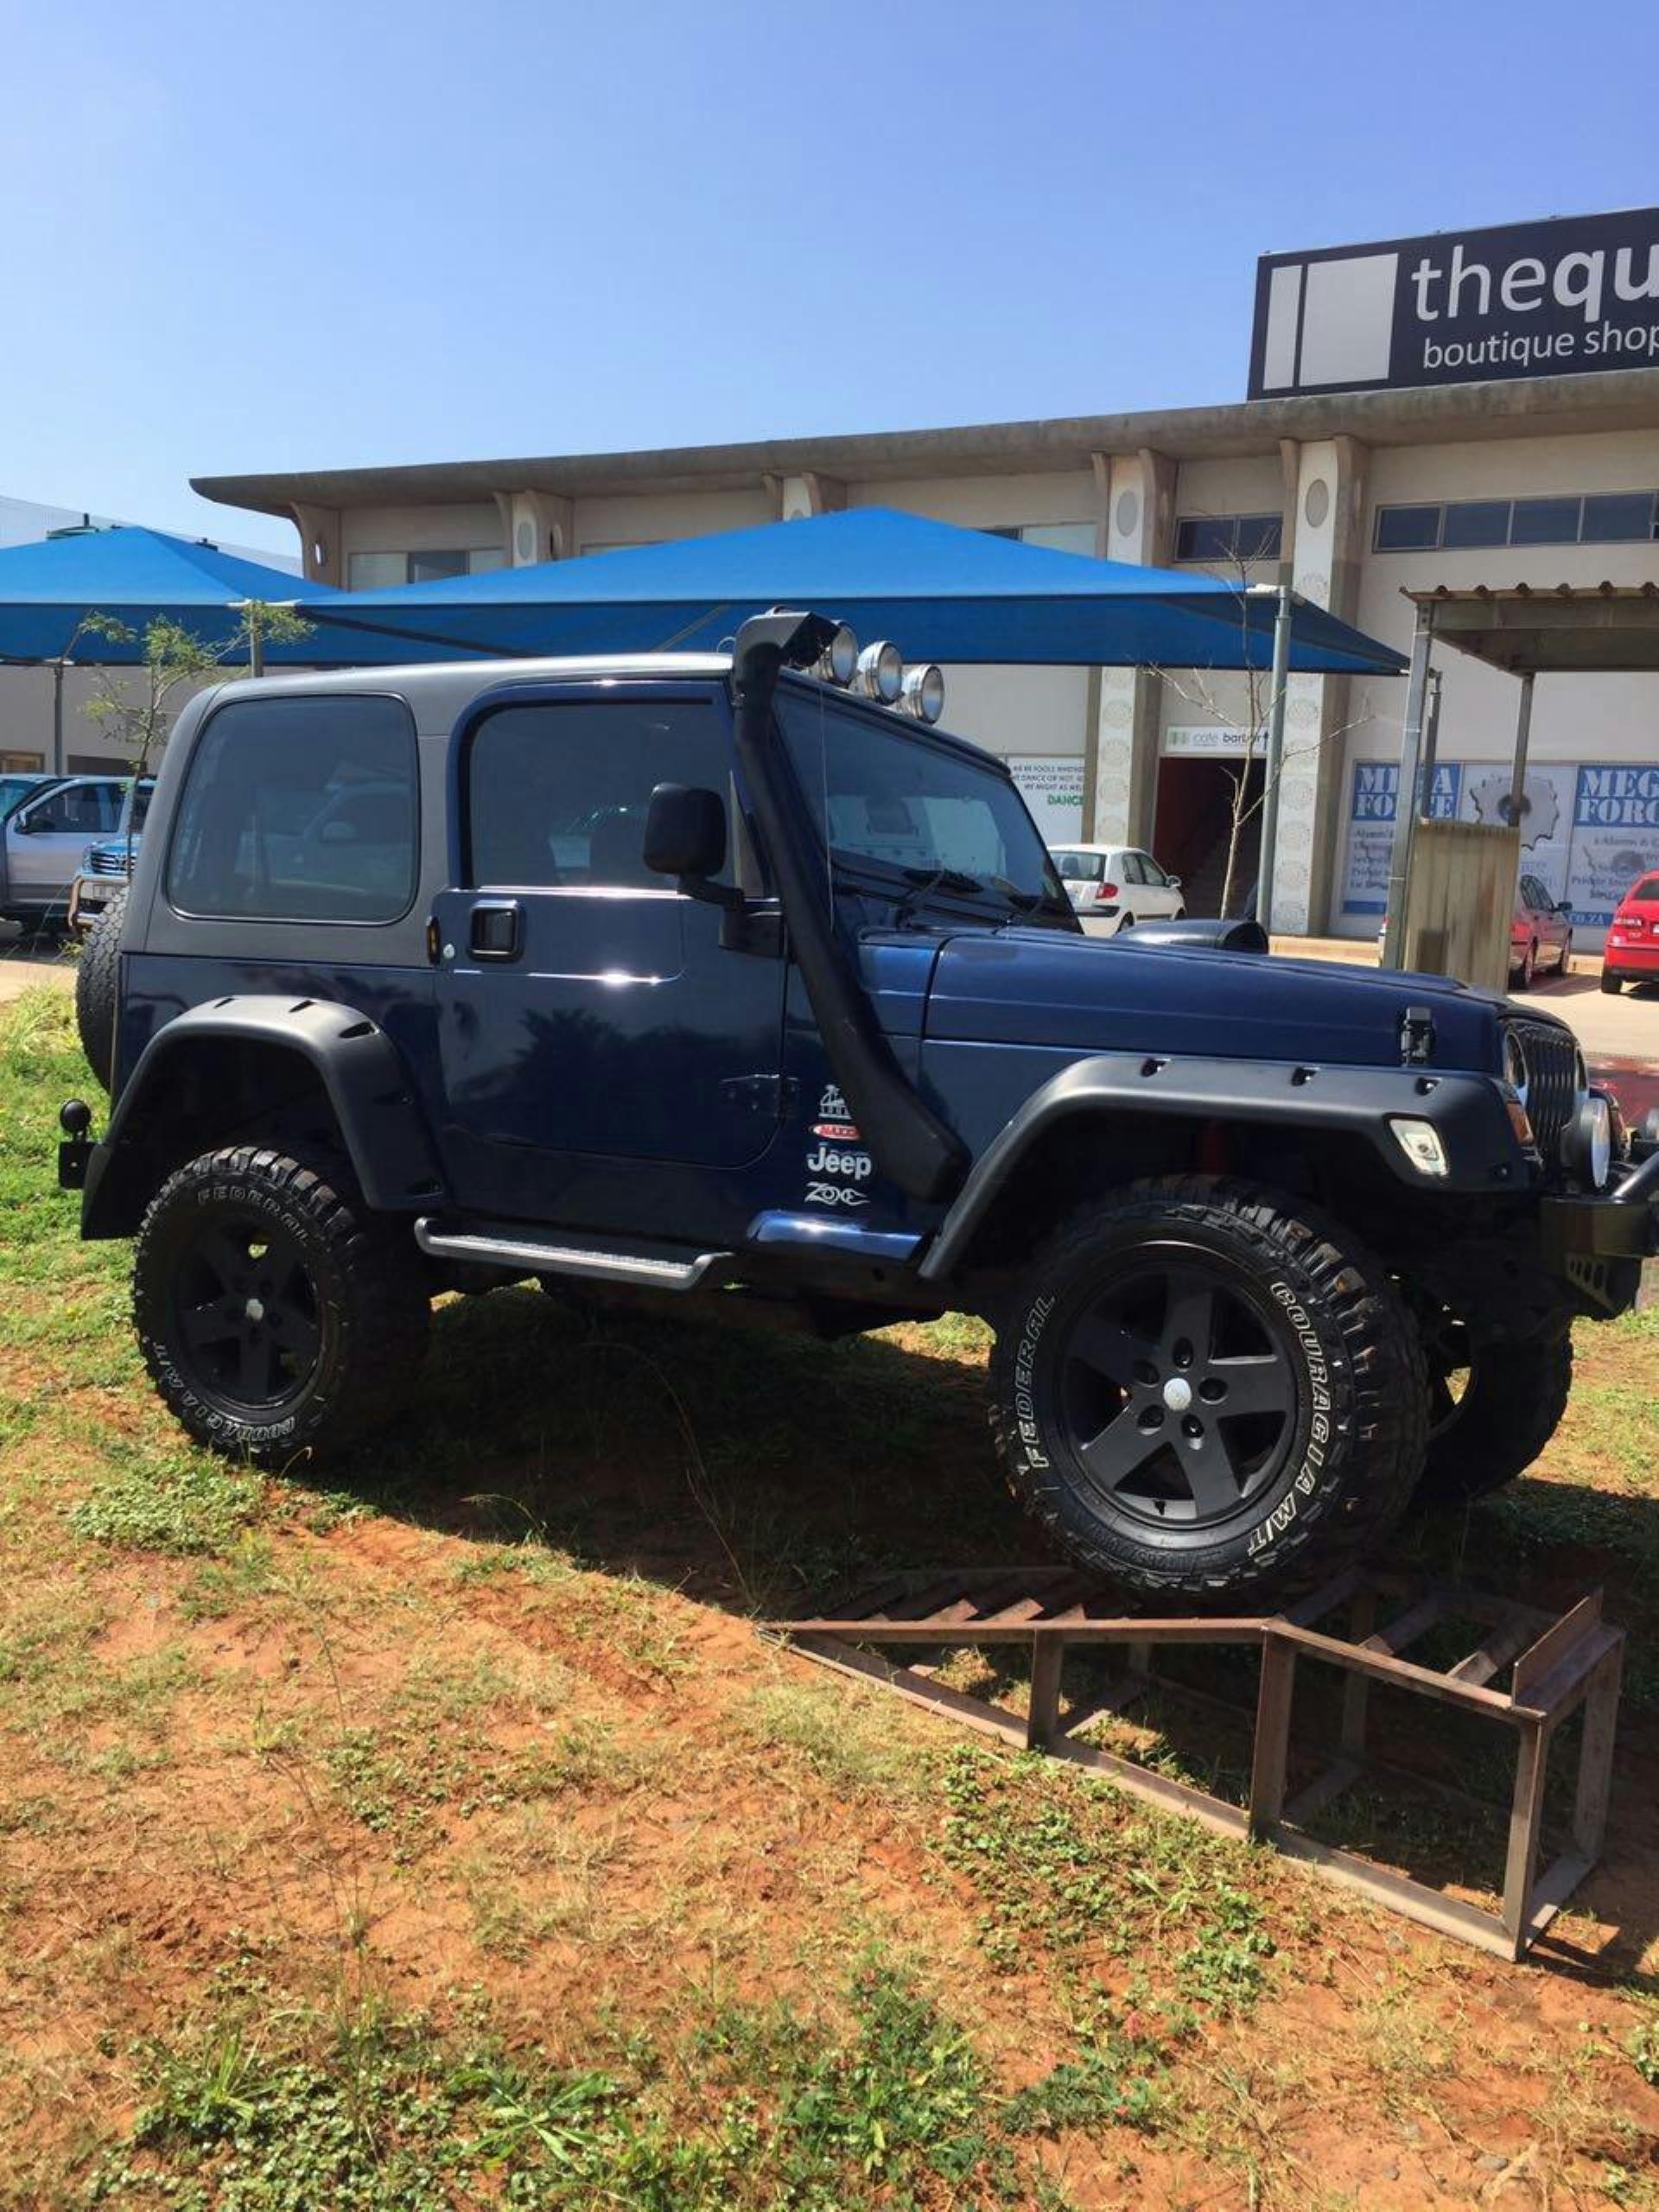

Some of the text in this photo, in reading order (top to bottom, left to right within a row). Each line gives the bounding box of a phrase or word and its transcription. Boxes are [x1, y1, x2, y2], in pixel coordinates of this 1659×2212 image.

[1411, 244, 1659, 323] thequ
[1423, 330, 1574, 370] boutique
[806, 1141, 872, 1180] Jeep
[1014, 1296, 1056, 1468] FEDERAL
[1270, 1281, 1332, 1496] COURAGIA
